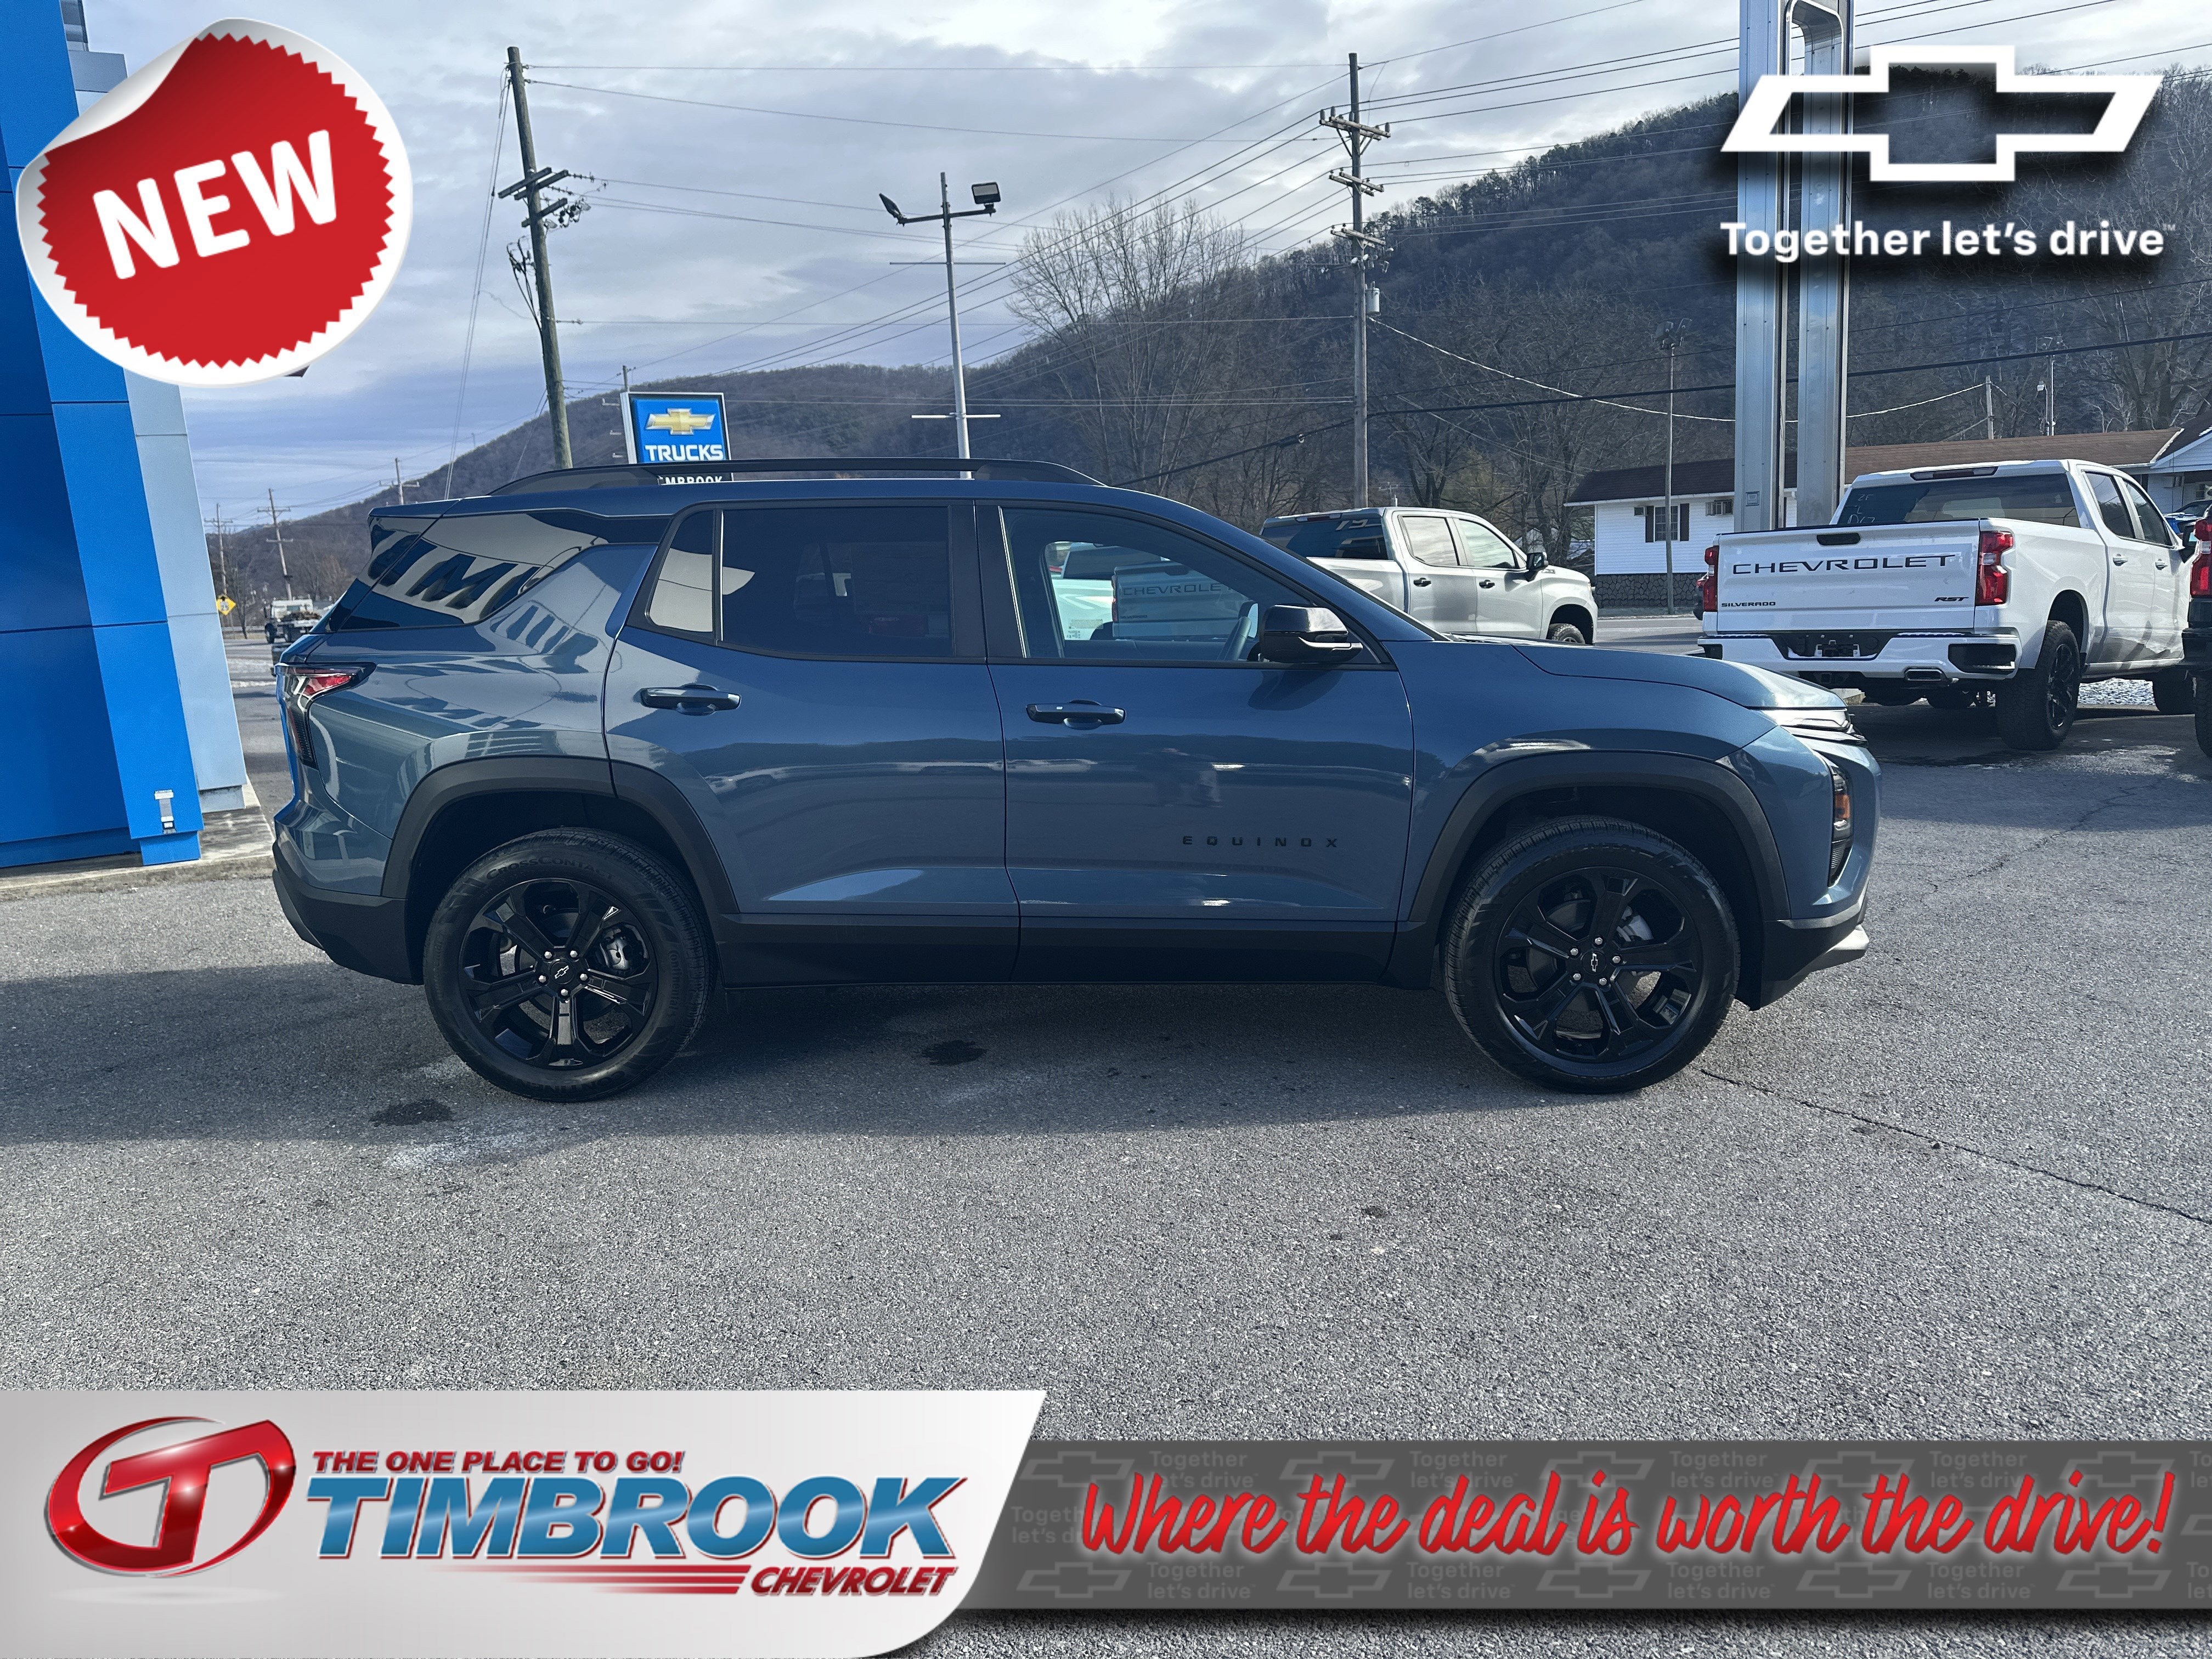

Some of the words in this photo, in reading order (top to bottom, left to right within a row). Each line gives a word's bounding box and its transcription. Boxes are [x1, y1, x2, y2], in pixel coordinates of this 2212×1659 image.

[645, 444, 724, 461] TRUCKS
[1733, 554, 1955, 574] CHEVROLET
[1182, 836, 1338, 848] EQUINOX
